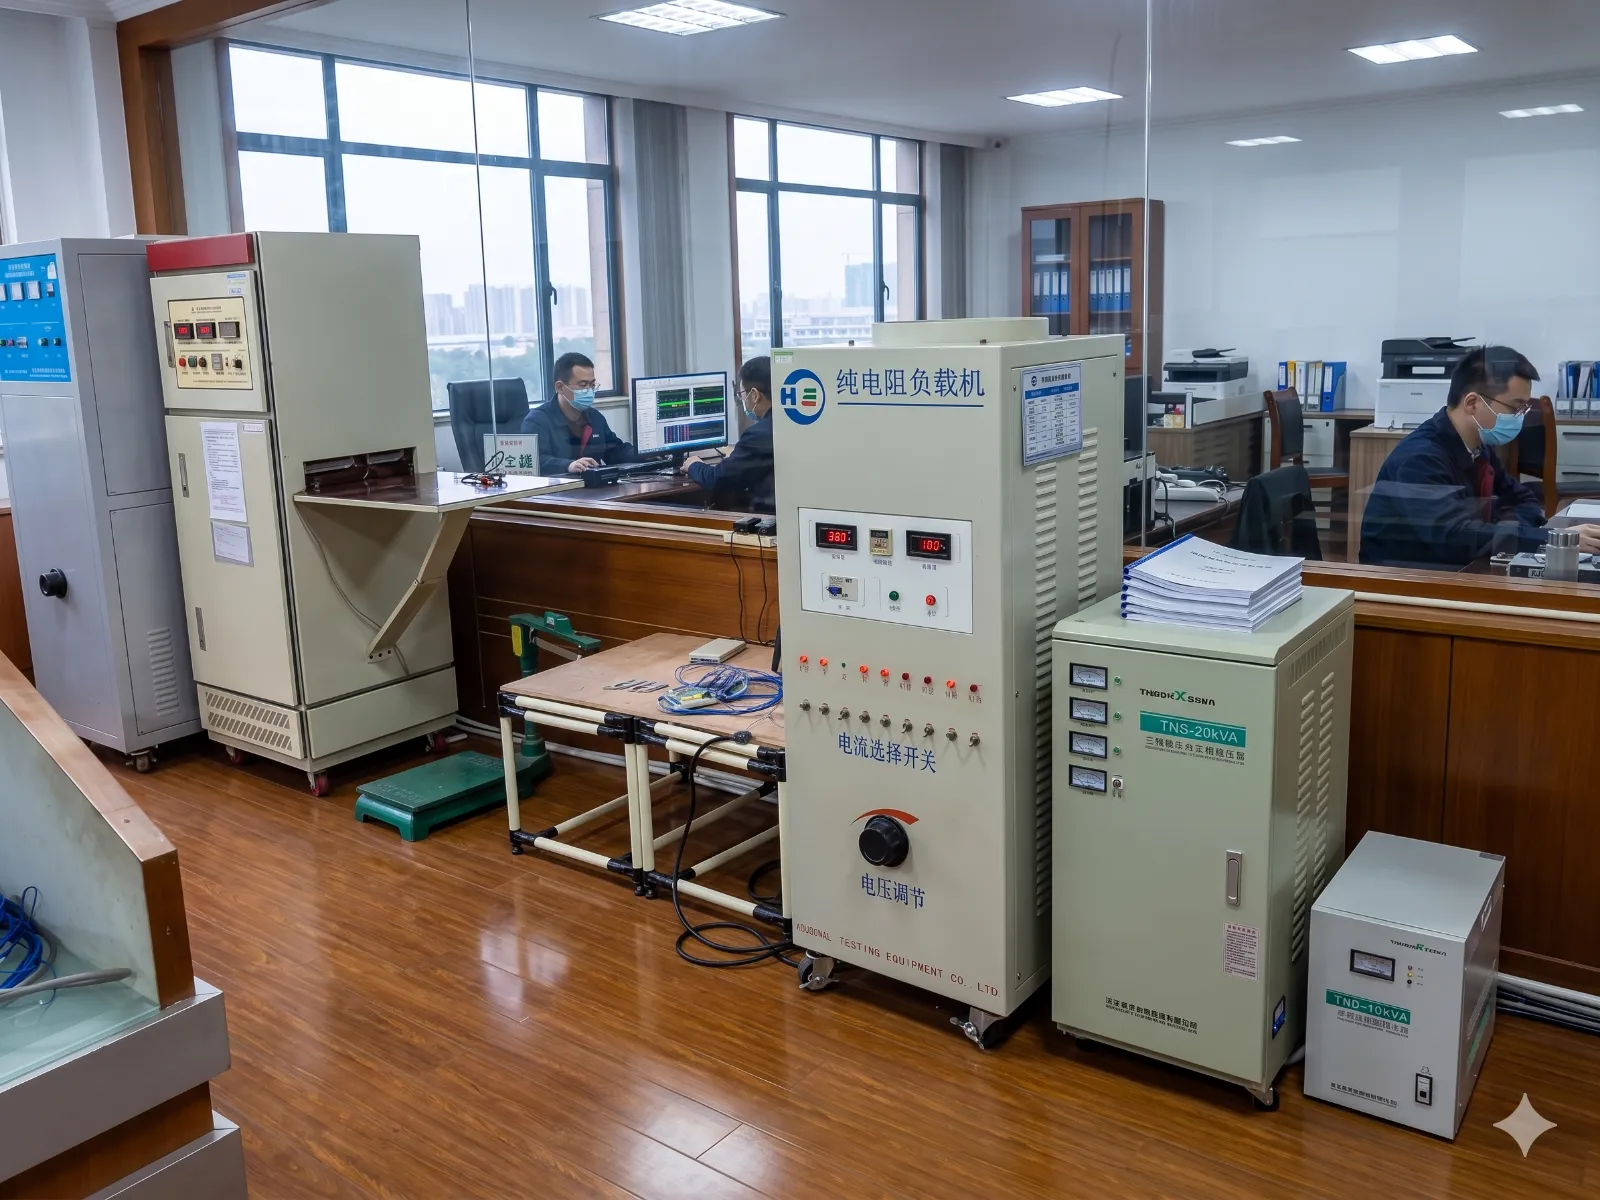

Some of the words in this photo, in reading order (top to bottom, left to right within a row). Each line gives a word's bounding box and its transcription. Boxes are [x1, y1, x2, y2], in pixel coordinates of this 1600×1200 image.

[836, 367, 986, 397] 纯电阻负载机
[828, 531, 847, 542] 380
[1160, 719, 1238, 743] TNS-20kVA
[838, 731, 936, 774] 电流选择开关
[861, 872, 925, 909] 电压调节
[839, 936, 880, 958] TESTING
[886, 952, 943, 978] EQUIPMENT
